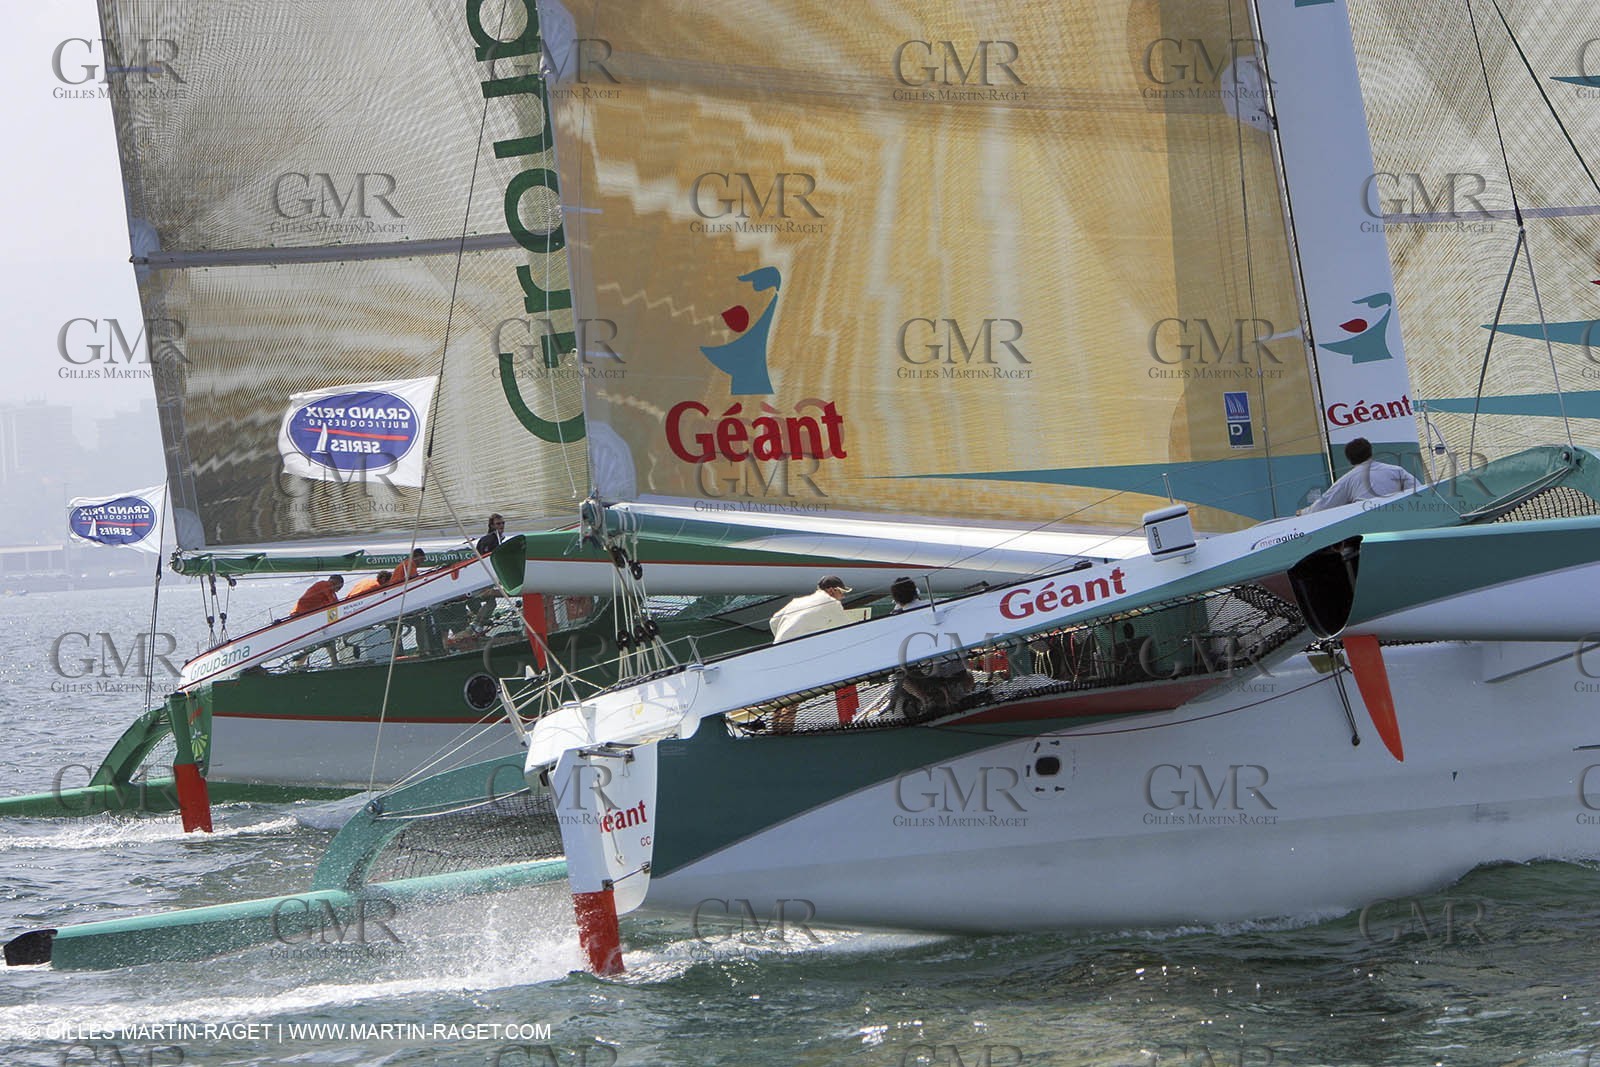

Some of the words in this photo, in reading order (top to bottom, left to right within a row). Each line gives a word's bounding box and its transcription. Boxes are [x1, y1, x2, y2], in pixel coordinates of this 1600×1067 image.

[1327, 394, 1412, 426] Géant
[665, 400, 847, 463] Géant
[999, 567, 1126, 620] Géant
[190, 644, 251, 681] Groupama
[600, 800, 647, 833] éant
